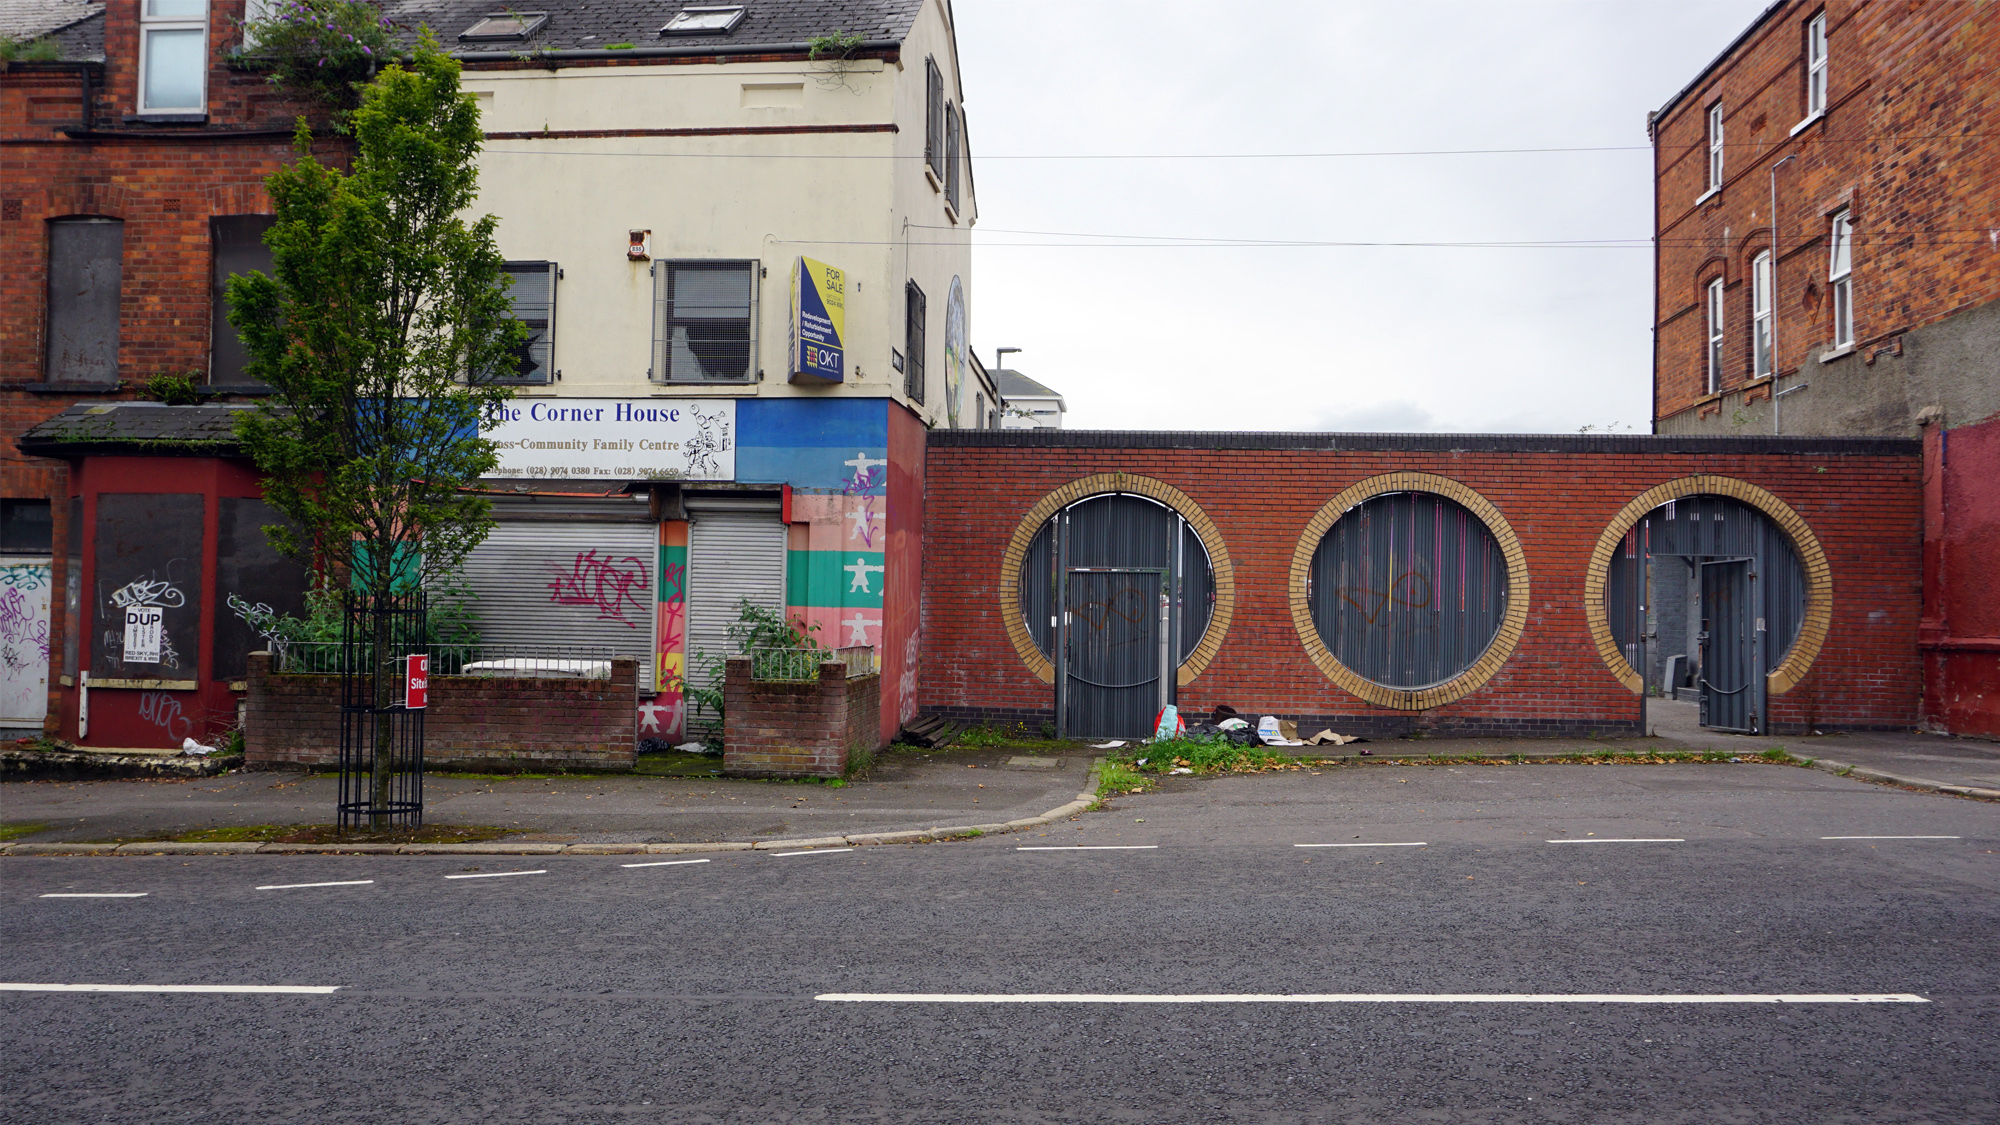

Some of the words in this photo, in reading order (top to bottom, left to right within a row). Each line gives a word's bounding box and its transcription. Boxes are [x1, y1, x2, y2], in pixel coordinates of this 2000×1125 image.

[826, 268, 840, 281] FOR
[826, 279, 843, 295] SALE
[802, 310, 831, 325] Redevelopment
[804, 320, 832, 334] Refurbishment
[801, 328, 825, 342] Opportunity
[818, 349, 840, 369] OKT
[530, 402, 605, 422] Corner
[615, 402, 680, 422] House
[489, 438, 588, 452] oss-Community
[593, 438, 635, 452] Family
[638, 438, 680, 450] Centre
[484, 466, 524, 475] elephone:
[526, 466, 548, 475] (028)
[571, 466, 591, 475] 0380
[593, 466, 611, 475] Fax:
[614, 466, 636, 476] (028)
[127, 613, 160, 625] DUP
